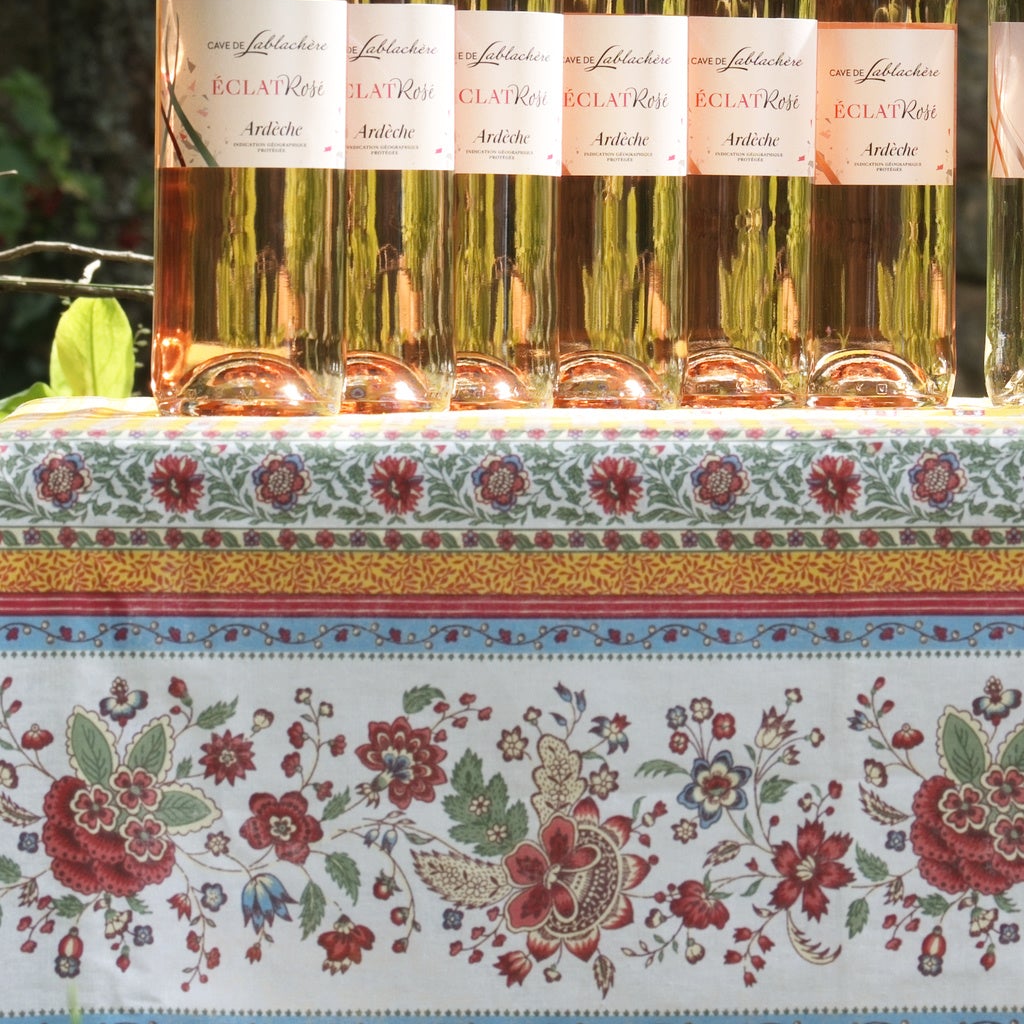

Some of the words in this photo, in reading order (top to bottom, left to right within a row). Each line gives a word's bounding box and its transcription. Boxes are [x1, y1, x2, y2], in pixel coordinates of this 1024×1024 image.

[207, 41, 230, 50] CAVE
[232, 41, 245, 50] DE
[233, 30, 327, 58] Lablachère
[348, 34, 438, 62] Lablachère
[466, 52, 477, 60] DE
[467, 40, 551, 68] Lablachère
[563, 56, 581, 64] AVE
[583, 56, 595, 64] DE
[584, 44, 671, 72] Lablachère
[691, 57, 713, 65] CAVE
[715, 57, 726, 65] DE
[716, 46, 803, 74] Lablachère
[829, 69, 851, 77] CAVE
[853, 57, 940, 85] Lablachère
[853, 69, 864, 77] DE
[211, 75, 285, 96] ÉCLAT
[458, 88, 514, 105] CLAT
[563, 88, 632, 108] ÉCLAT
[695, 89, 762, 109] ÉCLAT
[834, 100, 900, 119] ÉCLAT
[240, 120, 303, 136] Ardèche
[354, 124, 415, 139] Ardèche
[473, 129, 530, 144] Ardèche
[590, 131, 650, 147] Ardèche
[721, 132, 780, 147] Ardèche
[860, 142, 919, 157] Ardèche
